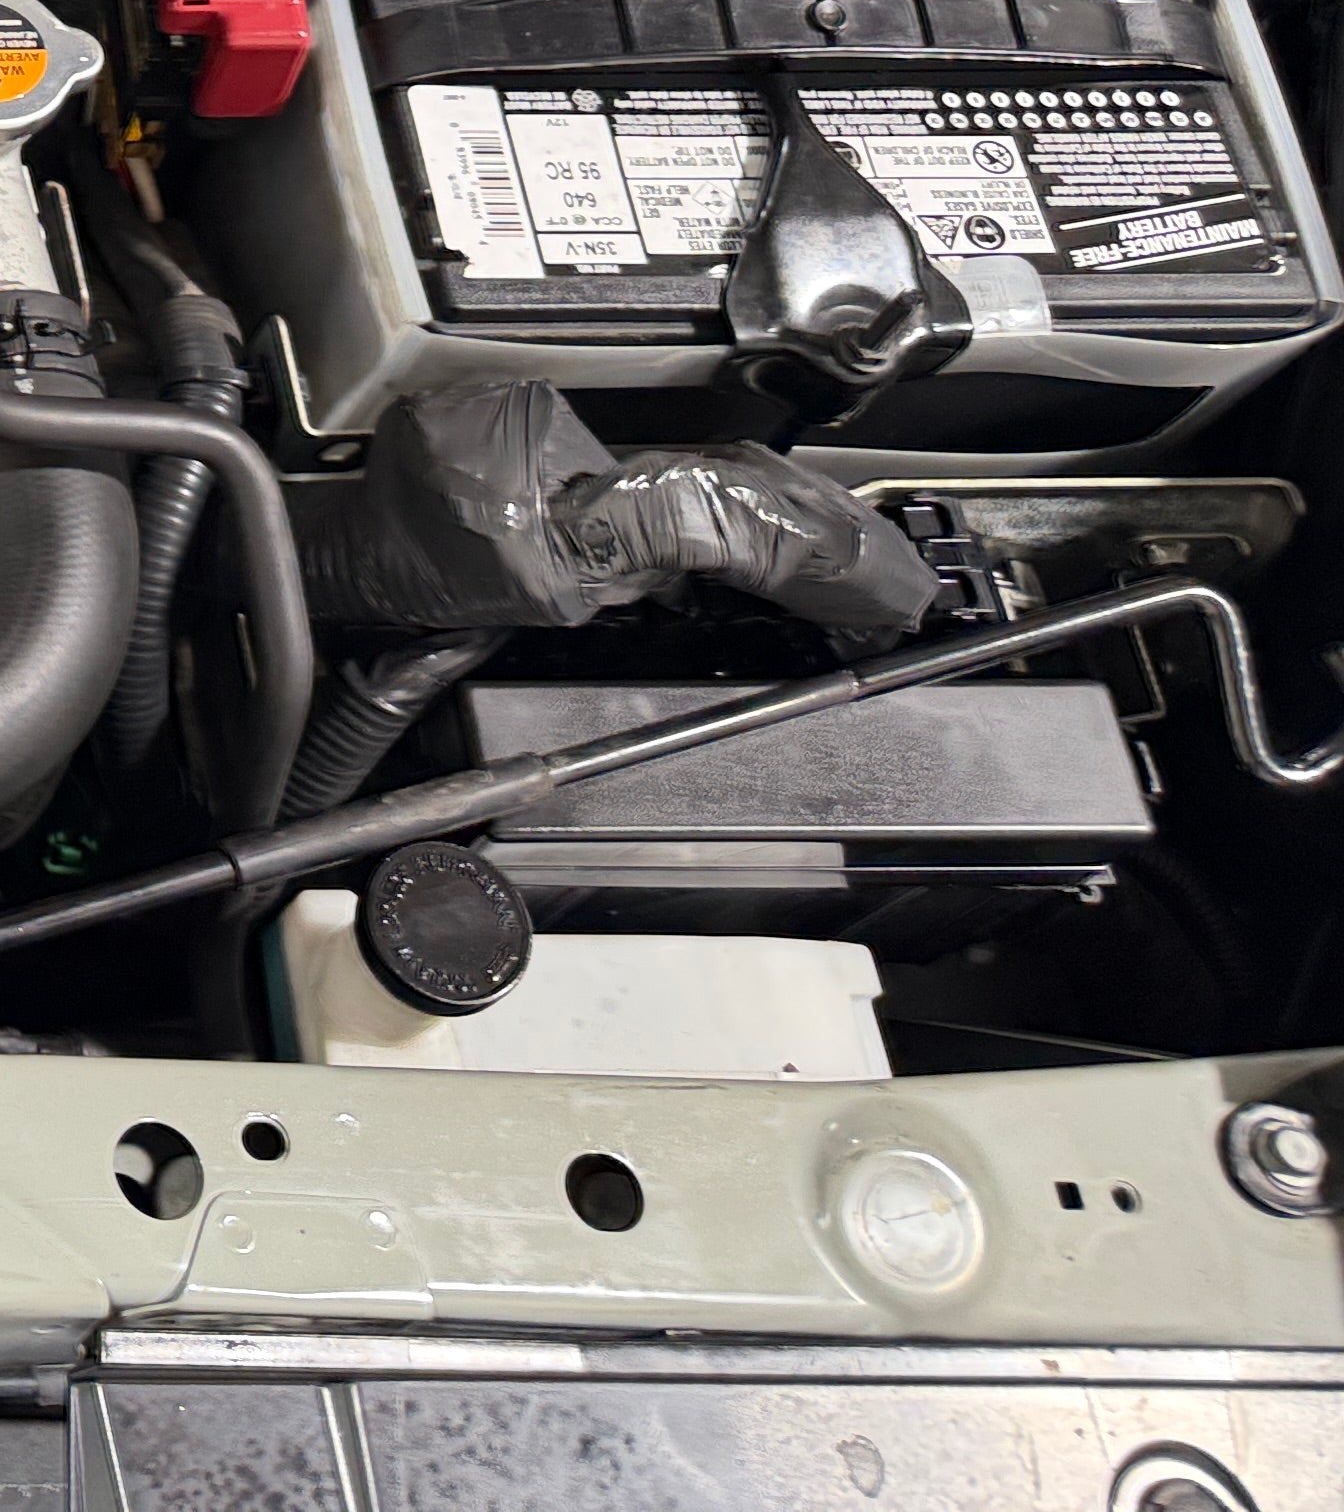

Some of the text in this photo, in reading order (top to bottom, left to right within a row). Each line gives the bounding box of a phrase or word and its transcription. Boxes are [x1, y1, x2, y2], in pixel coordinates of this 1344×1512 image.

[545, 118, 569, 127] 12V
[544, 161, 601, 180] 95 RC
[563, 191, 597, 208] 640
[573, 215, 587, 225] @
[592, 216, 623, 226] CCA
[1118, 210, 1203, 240] BATTERY
[565, 241, 618, 256] 35N-V
[1069, 218, 1261, 268] MAINTENANCE-FREE
